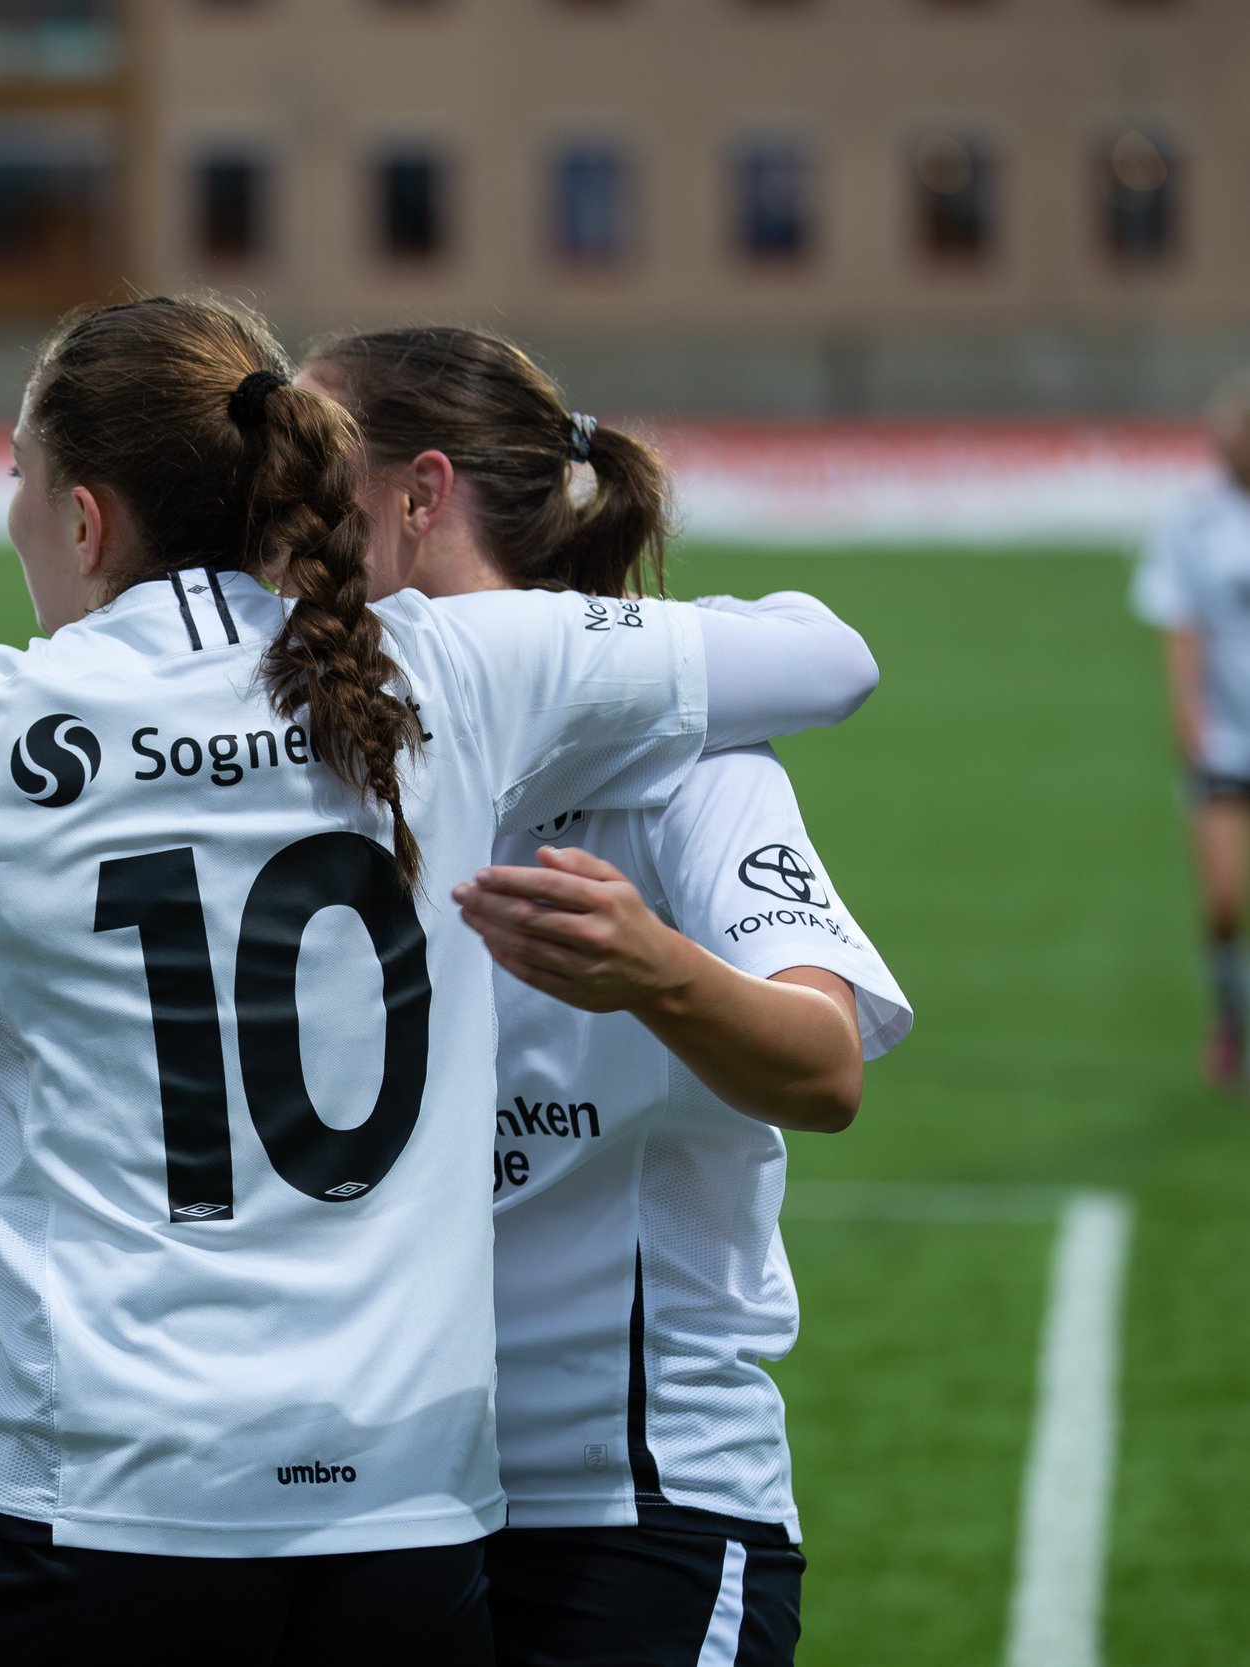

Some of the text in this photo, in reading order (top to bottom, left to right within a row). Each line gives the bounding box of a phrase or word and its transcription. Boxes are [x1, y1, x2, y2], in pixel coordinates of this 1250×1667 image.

[724, 910, 826, 943] TOYOTA
[93, 831, 432, 1223] 10
[276, 1460, 357, 1486] umbro
